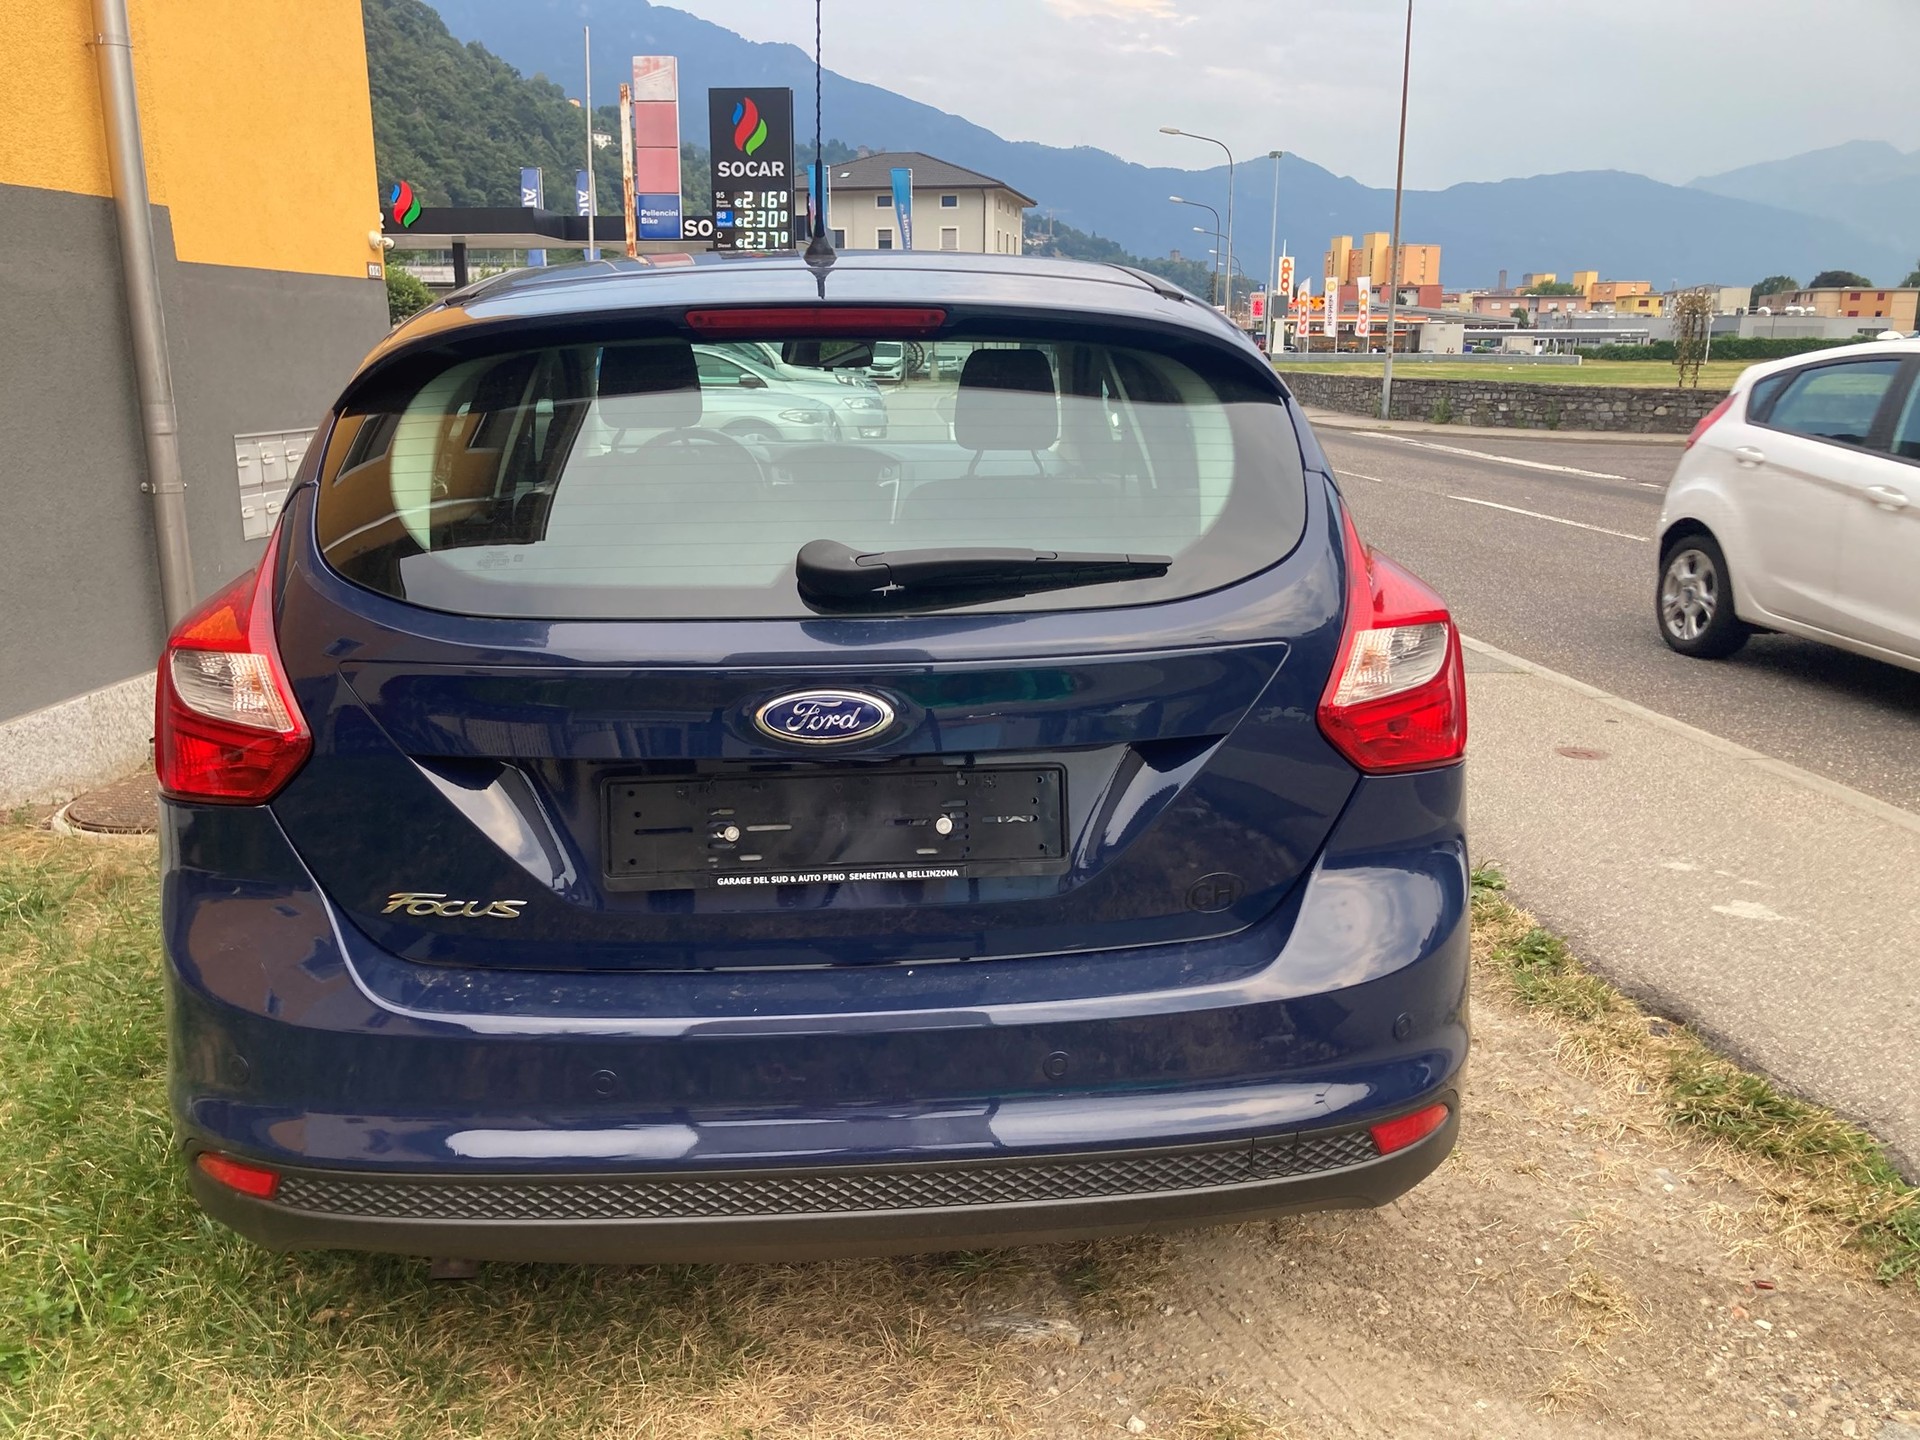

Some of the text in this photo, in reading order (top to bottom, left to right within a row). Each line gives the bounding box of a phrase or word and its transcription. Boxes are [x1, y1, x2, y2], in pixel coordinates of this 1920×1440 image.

[718, 161, 784, 177] SOCAR
[716, 191, 725, 199] 95
[641, 209, 679, 217] Pellencini
[716, 211, 726, 220] 98
[641, 217, 659, 225] Bike
[717, 231, 723, 239] D
[785, 700, 862, 732] Ford
[717, 876, 751, 885] GARAGE
[753, 875, 769, 884] DEL
[771, 875, 788, 883] SUD
[798, 873, 820, 882] AUTO
[822, 873, 845, 882] PENO
[849, 871, 897, 880] SEMENTINA
[899, 870, 905, 878] &
[907, 869, 958, 878] BELLINZONA
[1191, 882, 1235, 907] CH
